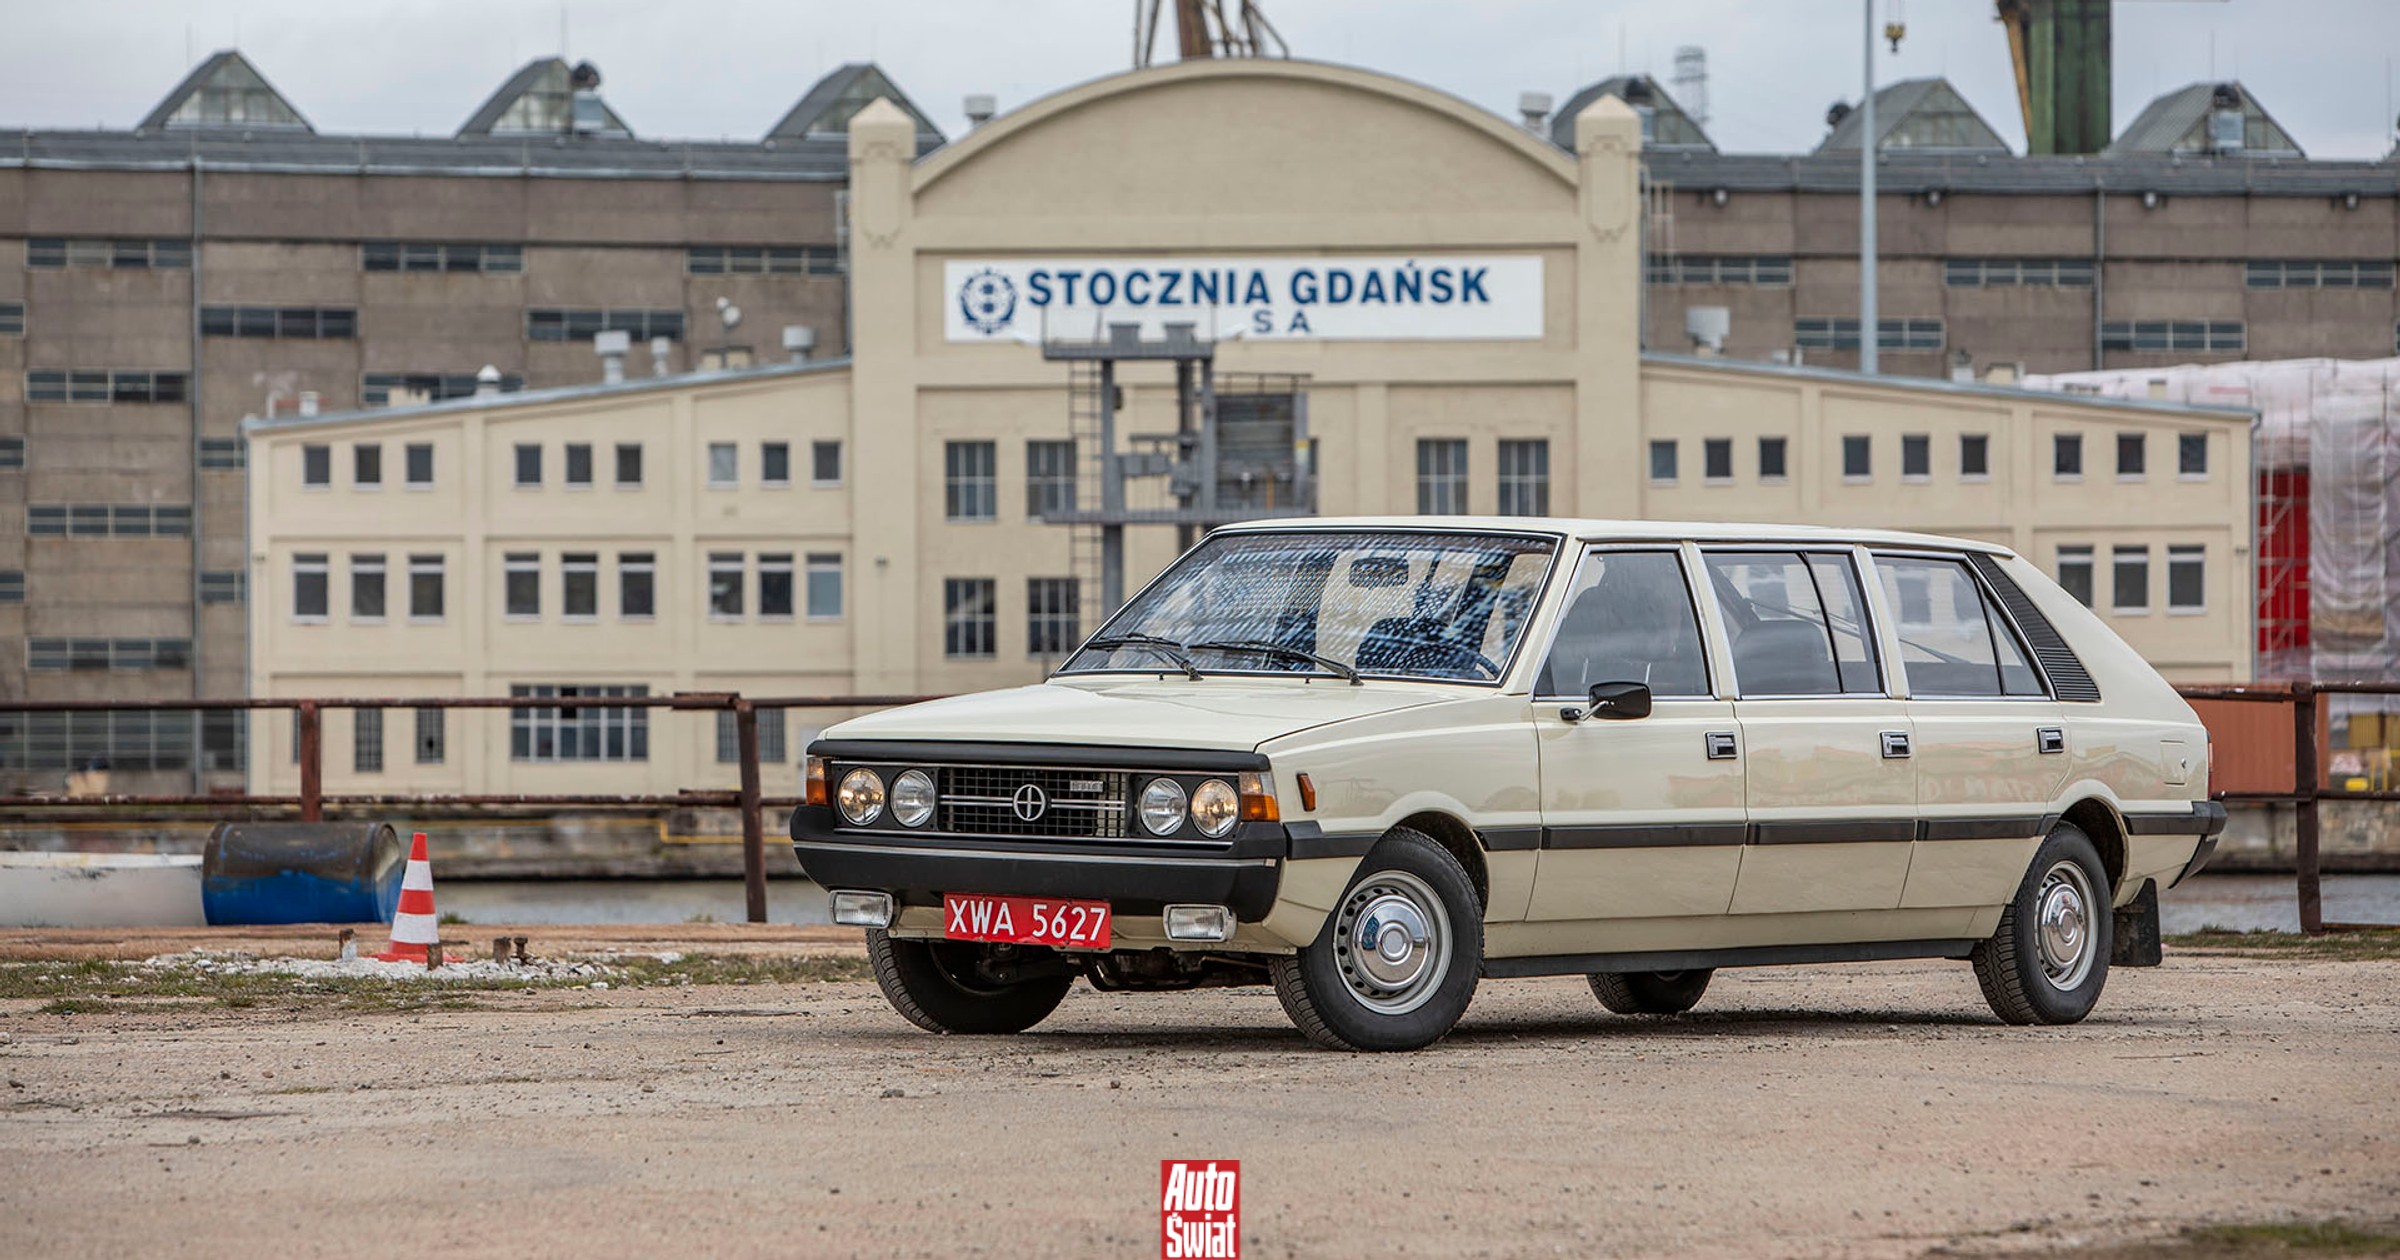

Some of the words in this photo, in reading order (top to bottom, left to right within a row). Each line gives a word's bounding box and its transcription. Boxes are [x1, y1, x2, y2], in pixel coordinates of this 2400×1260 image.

[1028, 268, 1271, 306] STOCZNIA
[1289, 259, 1489, 305] GDAŃSK
[949, 899, 1015, 936] XWA
[1032, 903, 1106, 942] 5627
